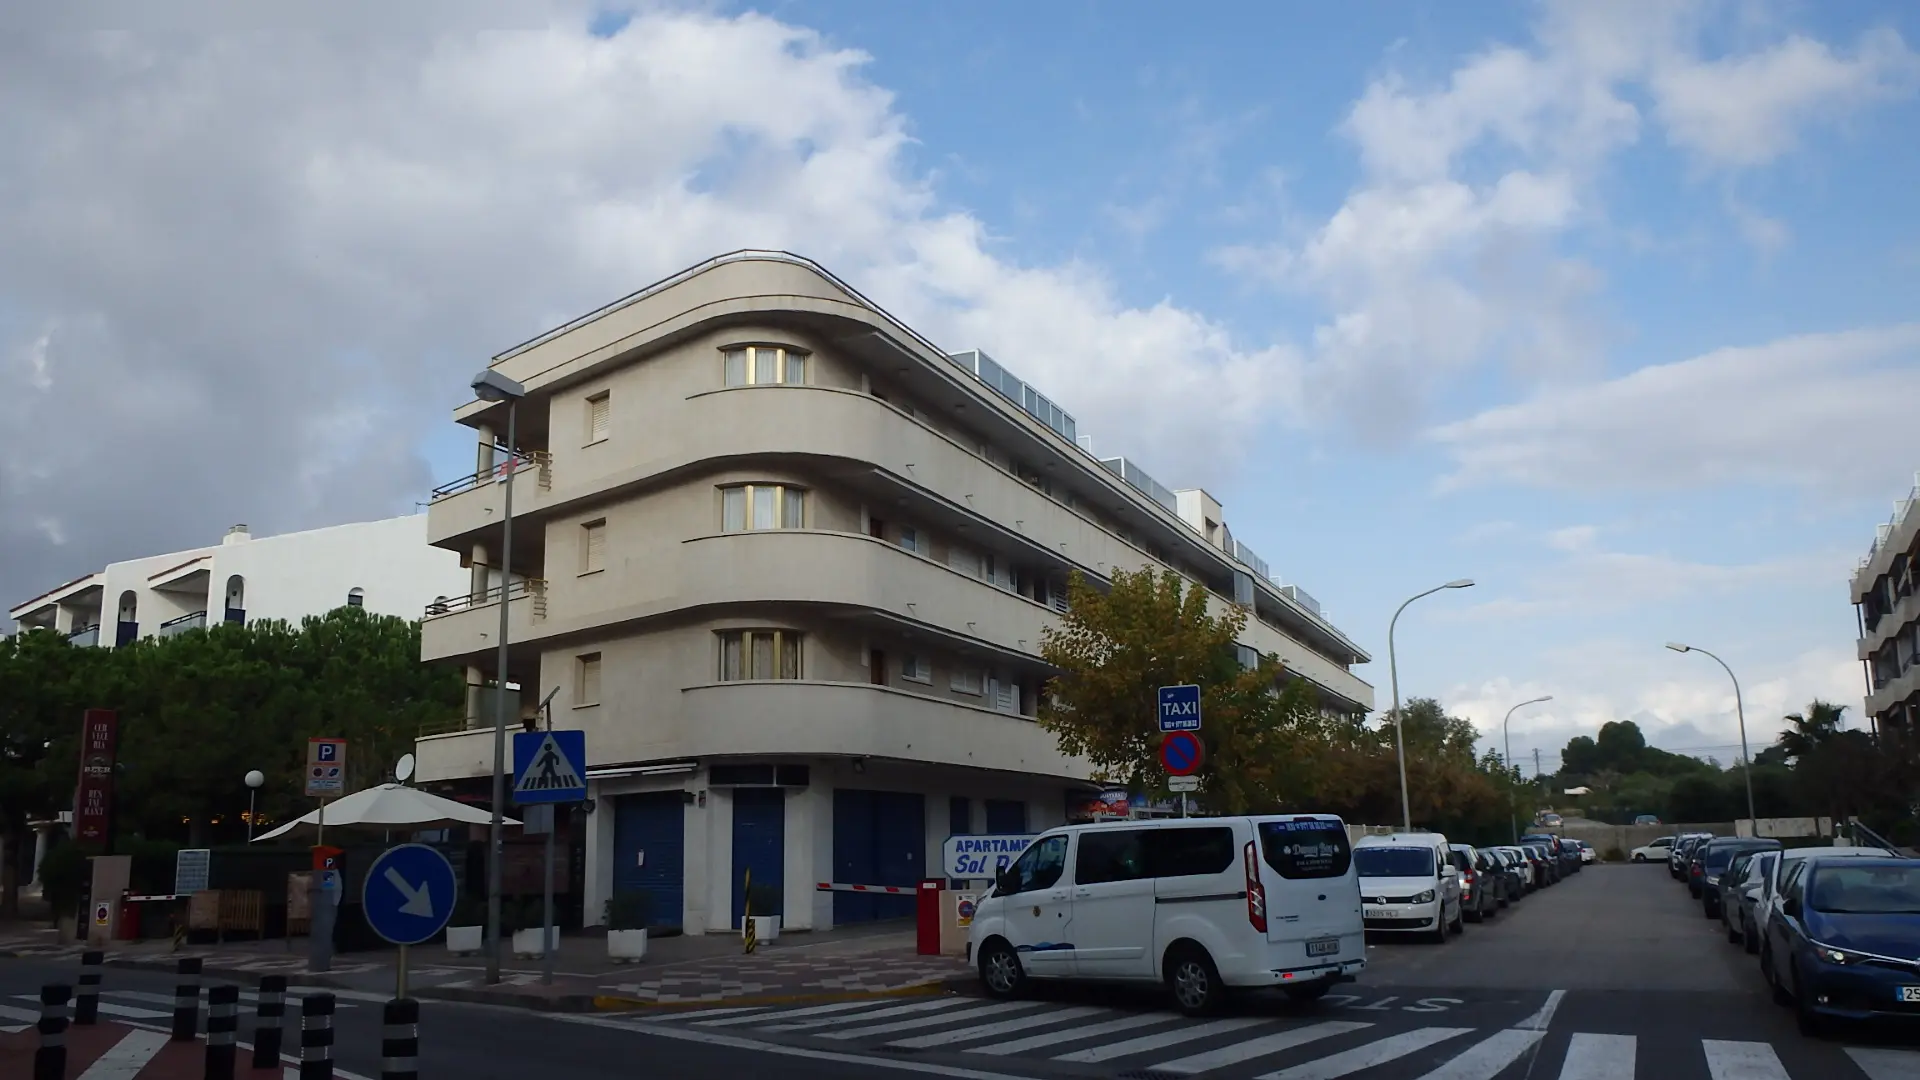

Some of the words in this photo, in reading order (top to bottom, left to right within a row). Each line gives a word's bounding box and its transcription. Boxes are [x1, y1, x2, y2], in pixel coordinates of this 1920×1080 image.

[1162, 702, 1197, 716] TAXI
[321, 745, 333, 760] P
[956, 840, 1031, 853] APARTAME
[326, 857, 334, 868] P
[955, 855, 987, 873] Sol
[1906, 989, 1920, 999] 25
